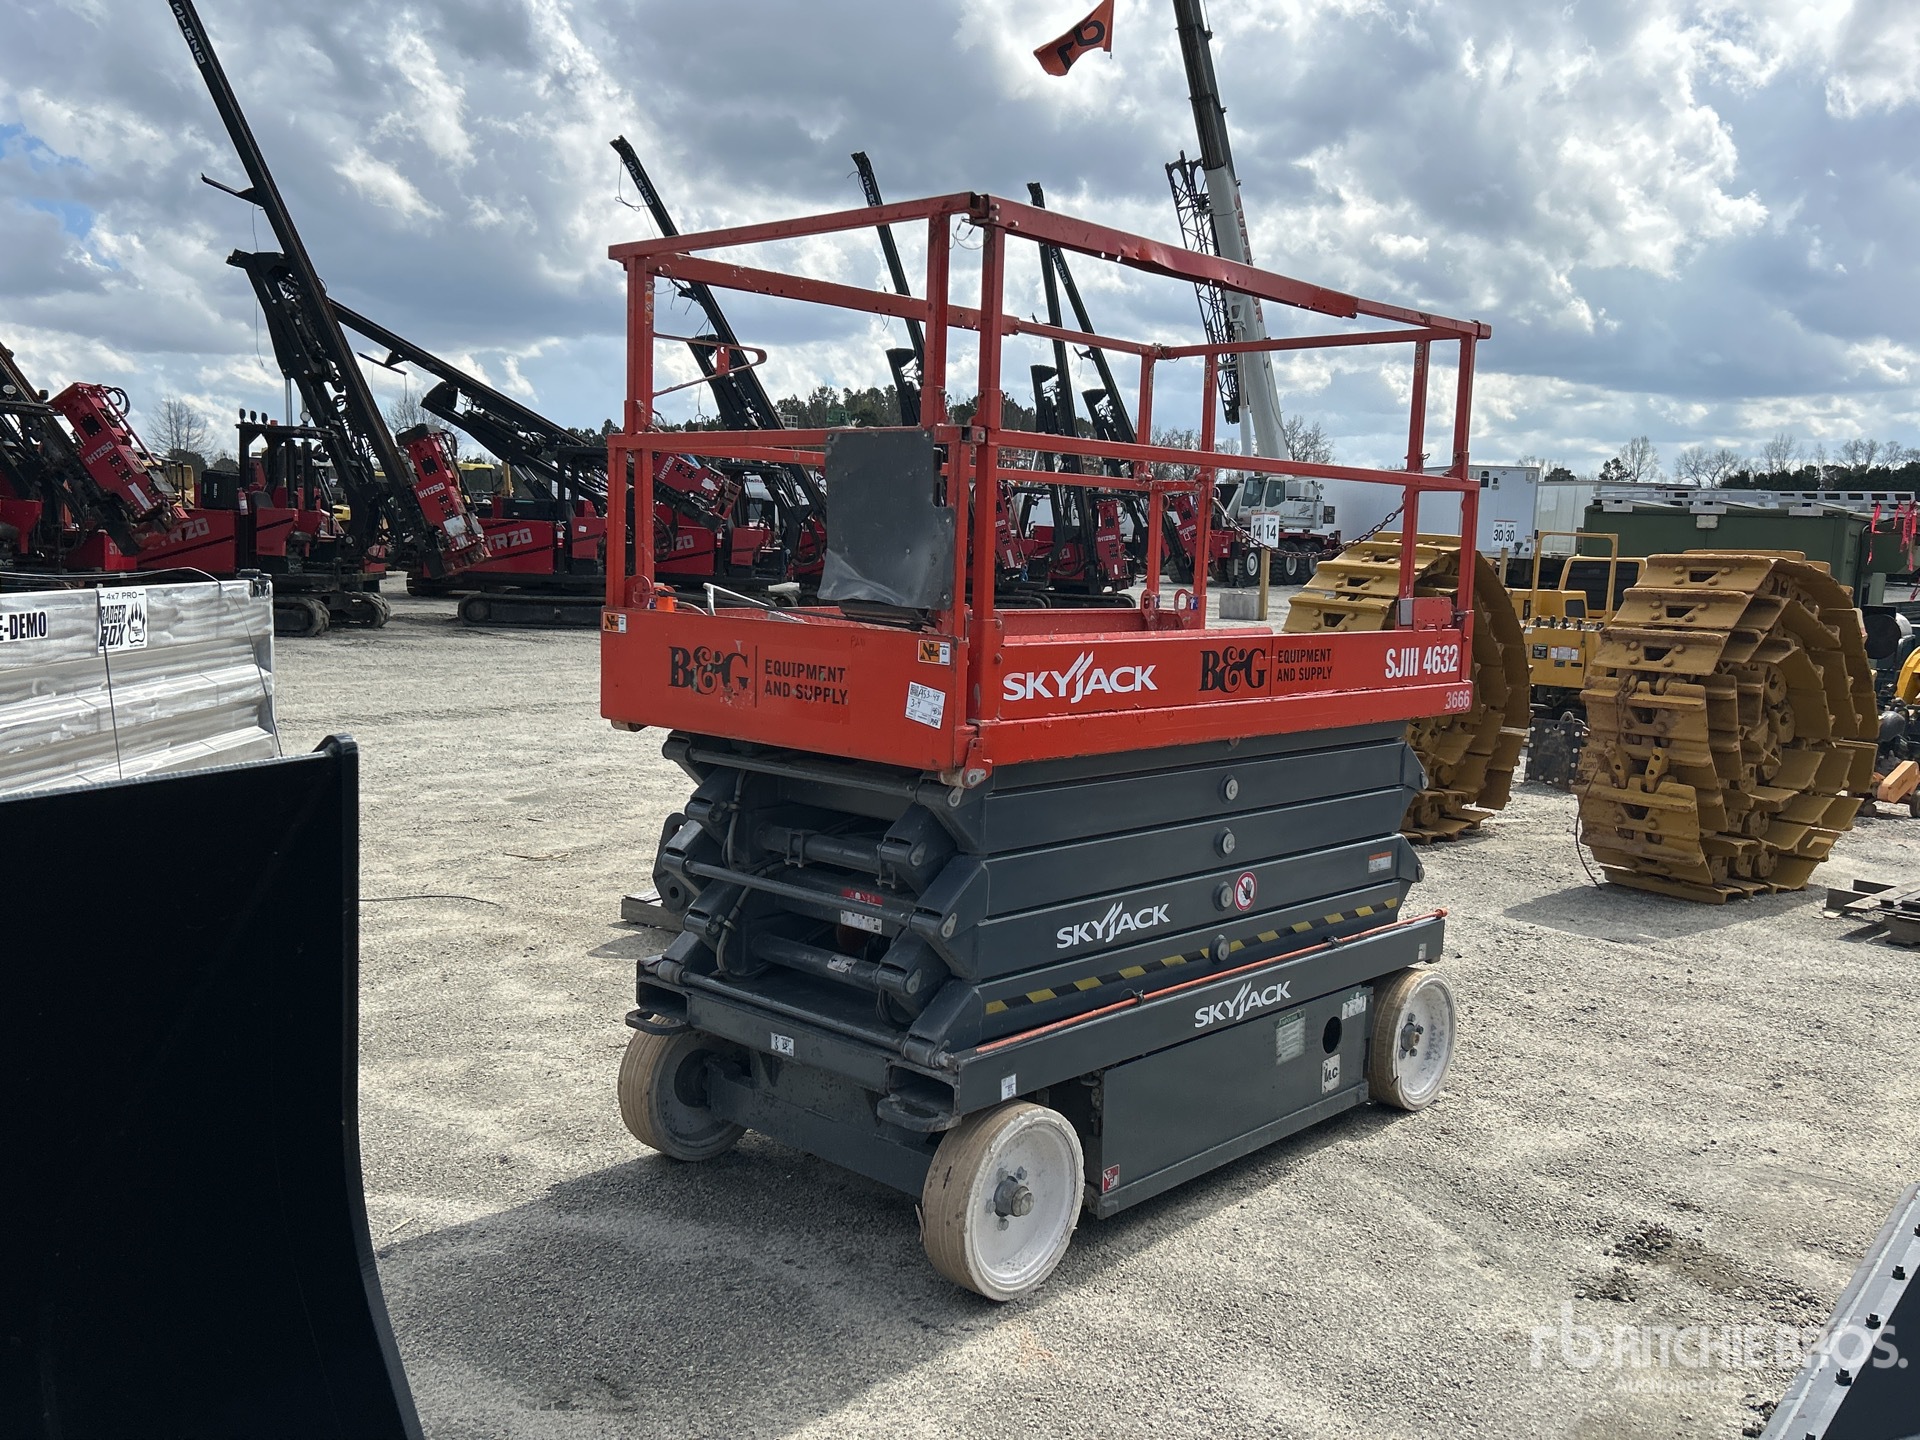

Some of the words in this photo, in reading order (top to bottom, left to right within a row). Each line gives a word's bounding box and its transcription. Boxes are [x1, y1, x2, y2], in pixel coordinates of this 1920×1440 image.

[1252, 524, 1262, 539] 14
[1266, 524, 1277, 539] 14
[1493, 529, 1504, 541] 30
[1505, 530, 1515, 542] 30
[121, 591, 138, 599] PRO
[99, 623, 126, 647] BOX
[1277, 648, 1332, 664] EQUIPMENT
[1422, 644, 1459, 675] 4632
[668, 645, 750, 697] B&G
[764, 659, 846, 684] EQUIPMENT
[1003, 651, 1158, 704] SKYJACK
[1198, 646, 1267, 694] B&G
[1276, 668, 1296, 682] AND
[1298, 666, 1333, 681] SUPPLY
[764, 680, 791, 698] AND
[795, 683, 848, 706] SUPPLY
[1445, 689, 1470, 709] 3666
[1056, 901, 1171, 949] SKYJACK
[1194, 980, 1292, 1028] SKYJACK
